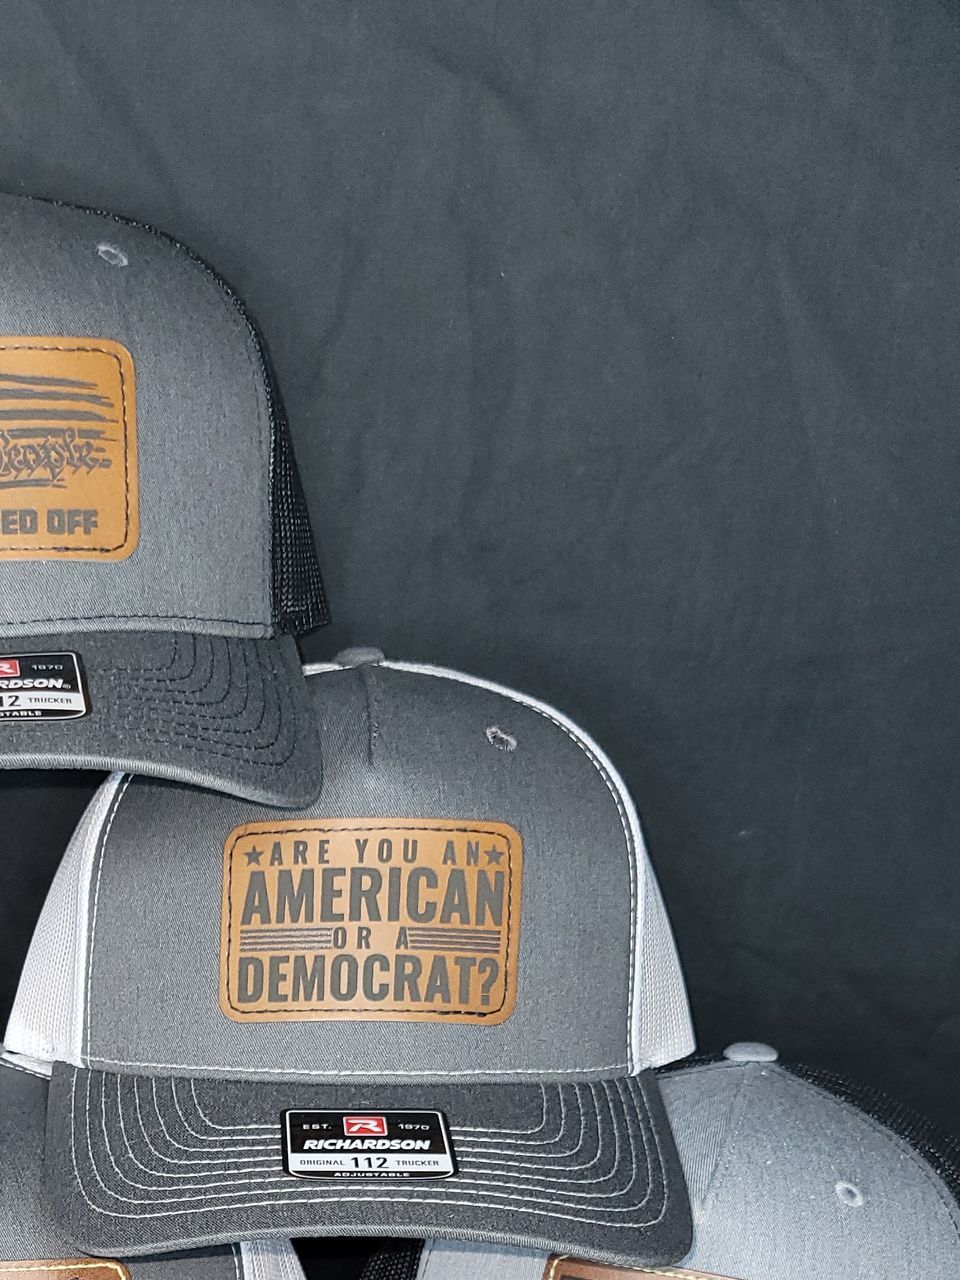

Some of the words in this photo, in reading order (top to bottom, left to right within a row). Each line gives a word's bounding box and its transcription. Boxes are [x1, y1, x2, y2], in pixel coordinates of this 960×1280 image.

[47, 509, 98, 535] OFF
[270, 839, 330, 866] ARE
[355, 839, 418, 863] YOU
[443, 840, 480, 866] AN
[241, 866, 504, 926] AMERICAN
[333, 927, 371, 949] OR
[396, 927, 409, 949] A
[237, 953, 499, 1005] DEMOCRAT?
[351, 1157, 389, 1168] 112
